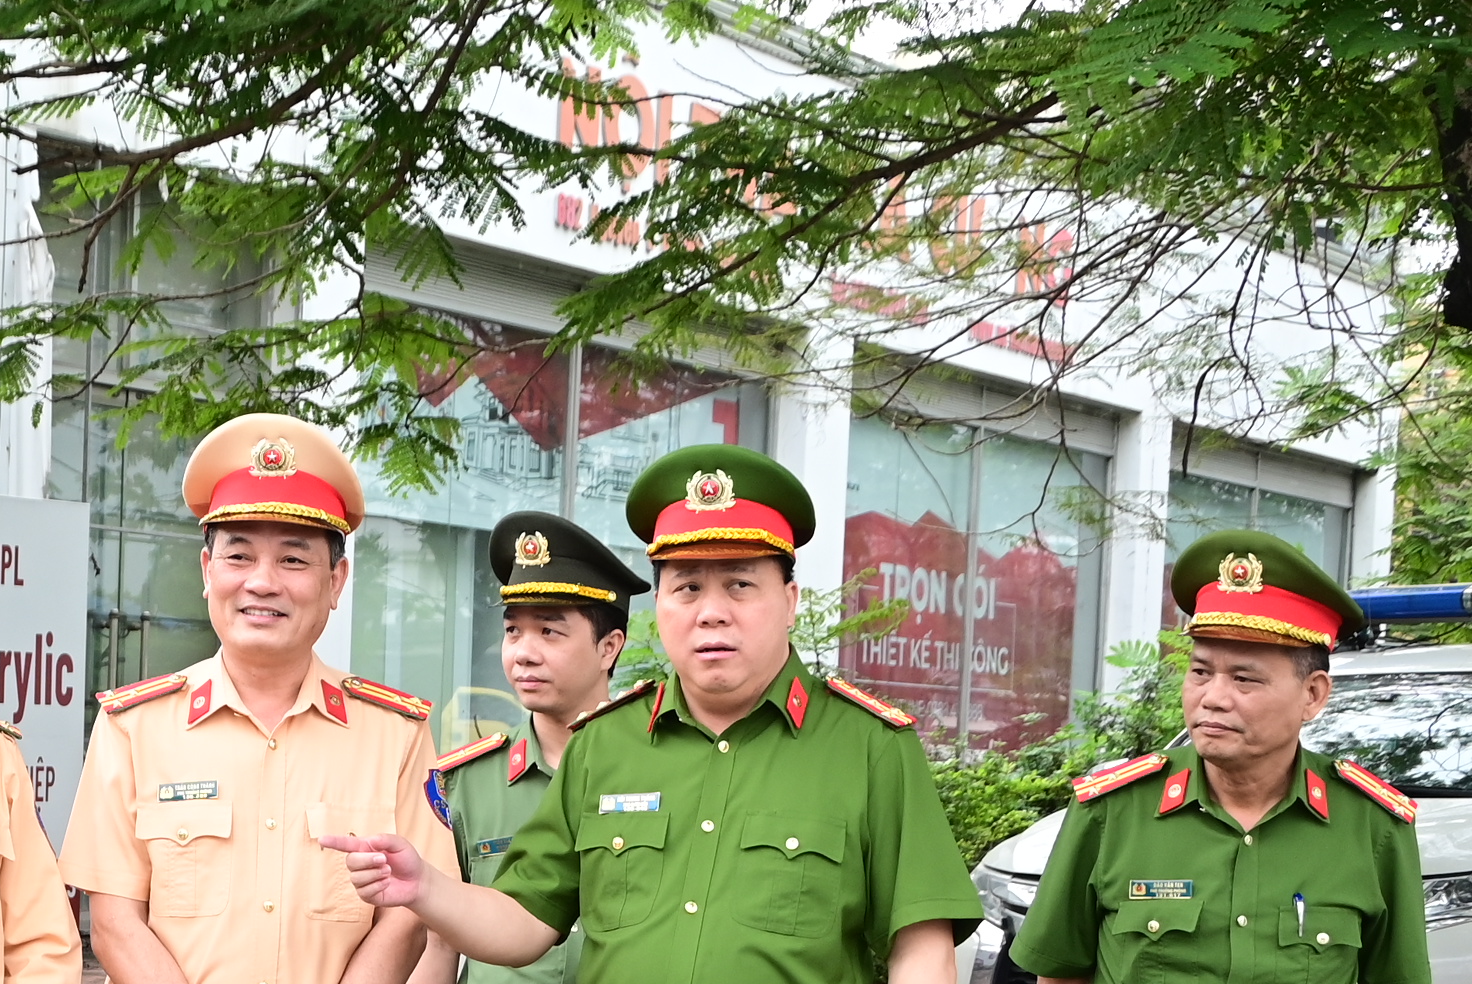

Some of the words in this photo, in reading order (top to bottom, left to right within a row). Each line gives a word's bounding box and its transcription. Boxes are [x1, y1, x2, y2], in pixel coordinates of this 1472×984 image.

[880, 562, 947, 625] TRỌN
[910, 630, 931, 668] KẾ
[934, 641, 960, 671] THI
